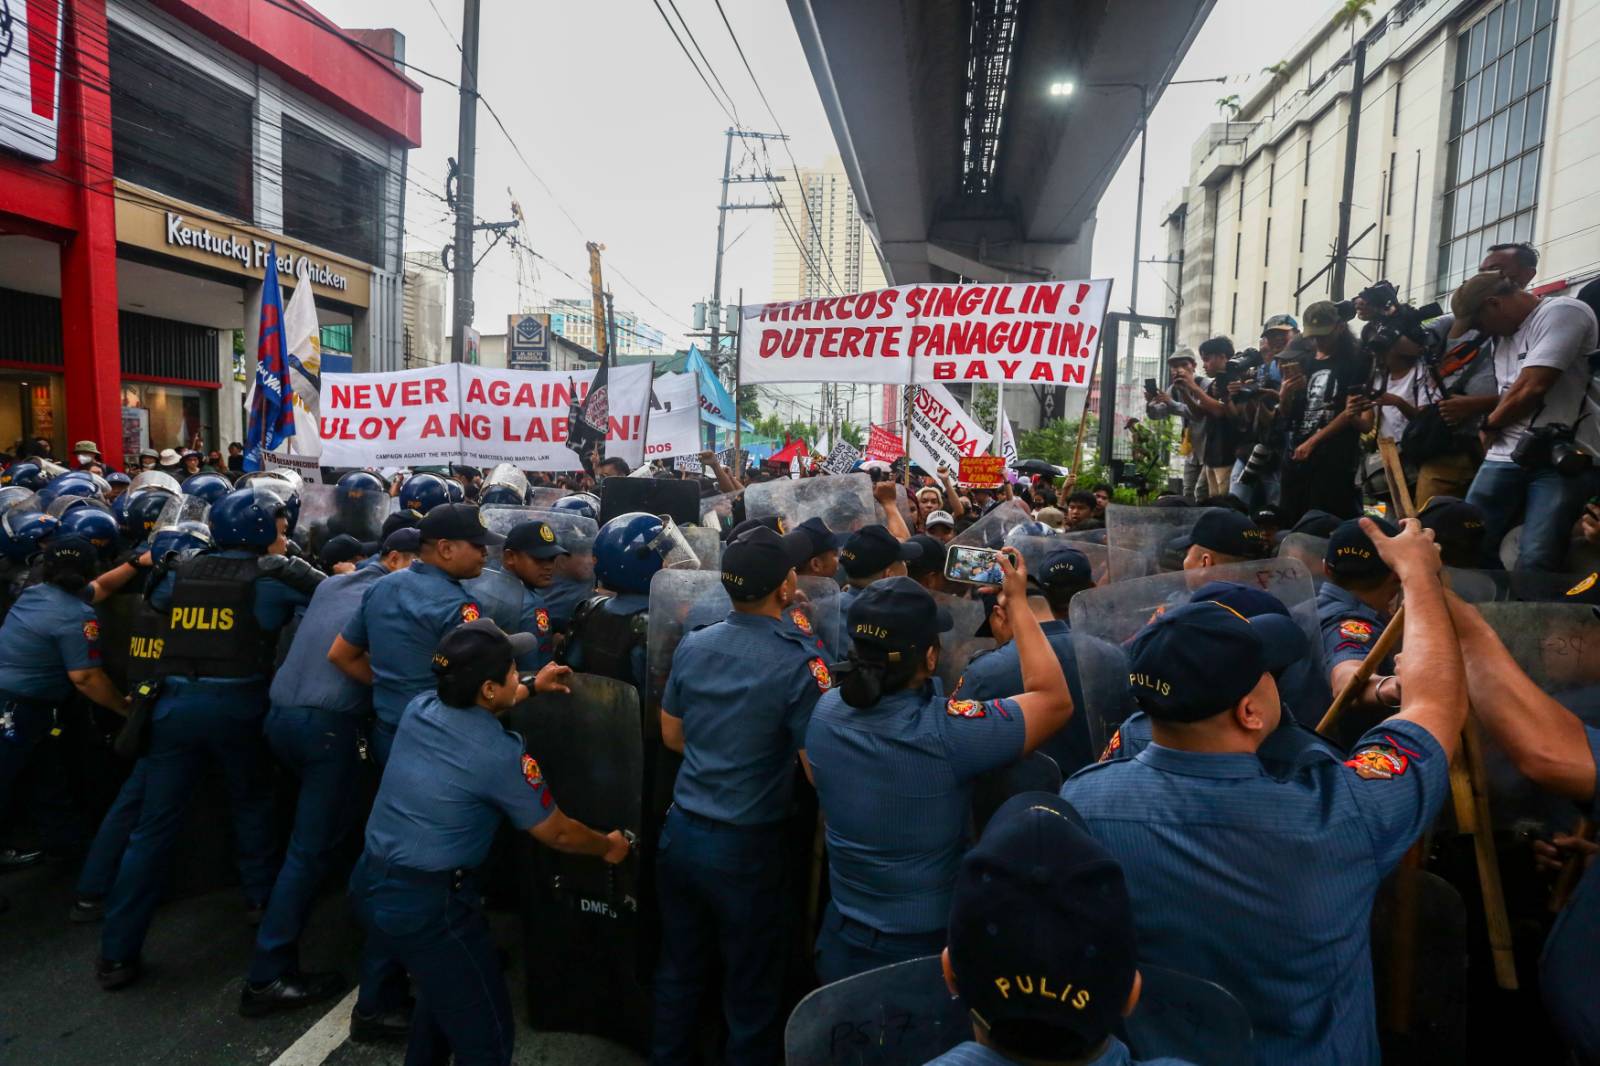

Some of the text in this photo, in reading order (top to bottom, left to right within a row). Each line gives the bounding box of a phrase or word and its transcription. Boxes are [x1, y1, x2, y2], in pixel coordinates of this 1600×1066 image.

[166, 212, 250, 268] Kentucky
[253, 240, 293, 274] Fred
[760, 289, 900, 322] MARCOS
[759, 320, 1098, 358] DUTERTE PANAGUTIN!
[933, 360, 1086, 384] BAYAN
[331, 377, 589, 409] NEVER AGAIN!
[420, 413, 492, 441] ANG
[503, 415, 641, 442] LABN!
[914, 388, 978, 457] SELDA
[1336, 546, 1370, 558] PULIS
[170, 607, 234, 630] PULIS
[856, 624, 888, 639] PULIS
[130, 636, 164, 659] PULIS
[1129, 672, 1170, 696] PULIS
[995, 975, 1089, 1010] PULIS
